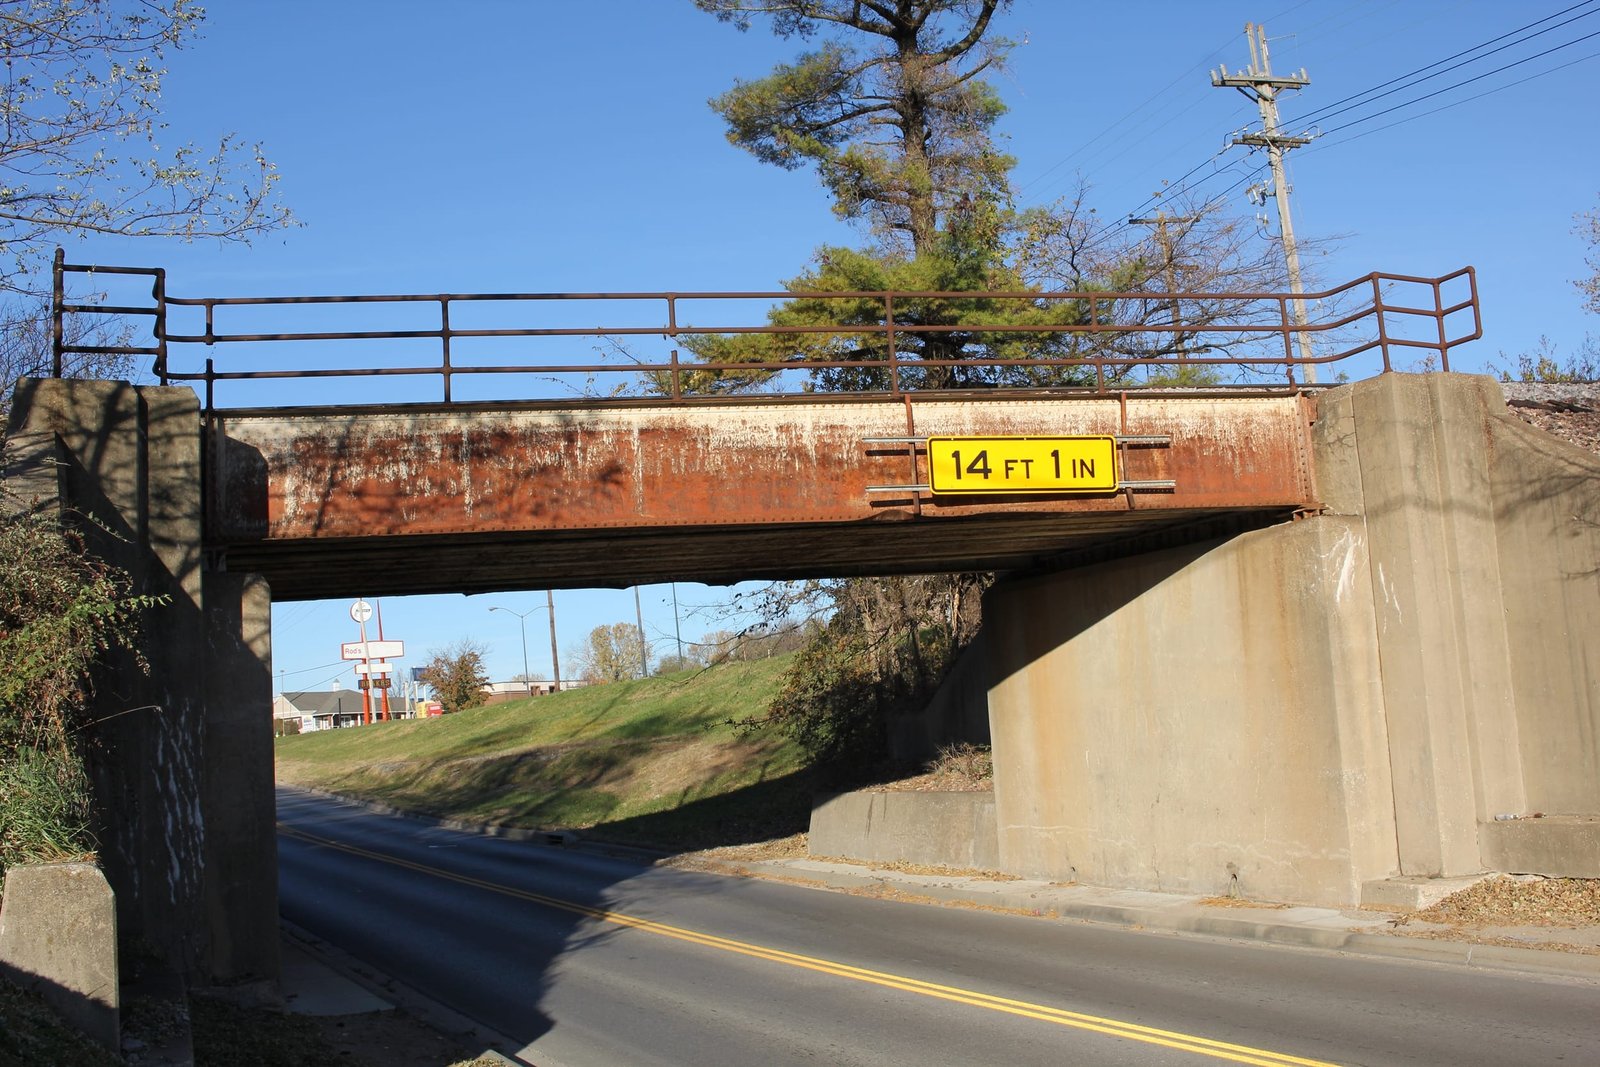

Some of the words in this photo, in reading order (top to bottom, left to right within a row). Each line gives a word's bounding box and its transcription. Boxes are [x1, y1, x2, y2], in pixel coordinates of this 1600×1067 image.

[951, 450, 993, 480] 14
[1004, 459, 1034, 479] FT
[1050, 449, 1061, 479] 1
[1072, 458, 1095, 479] IN
[344, 647, 362, 655] Rod's
